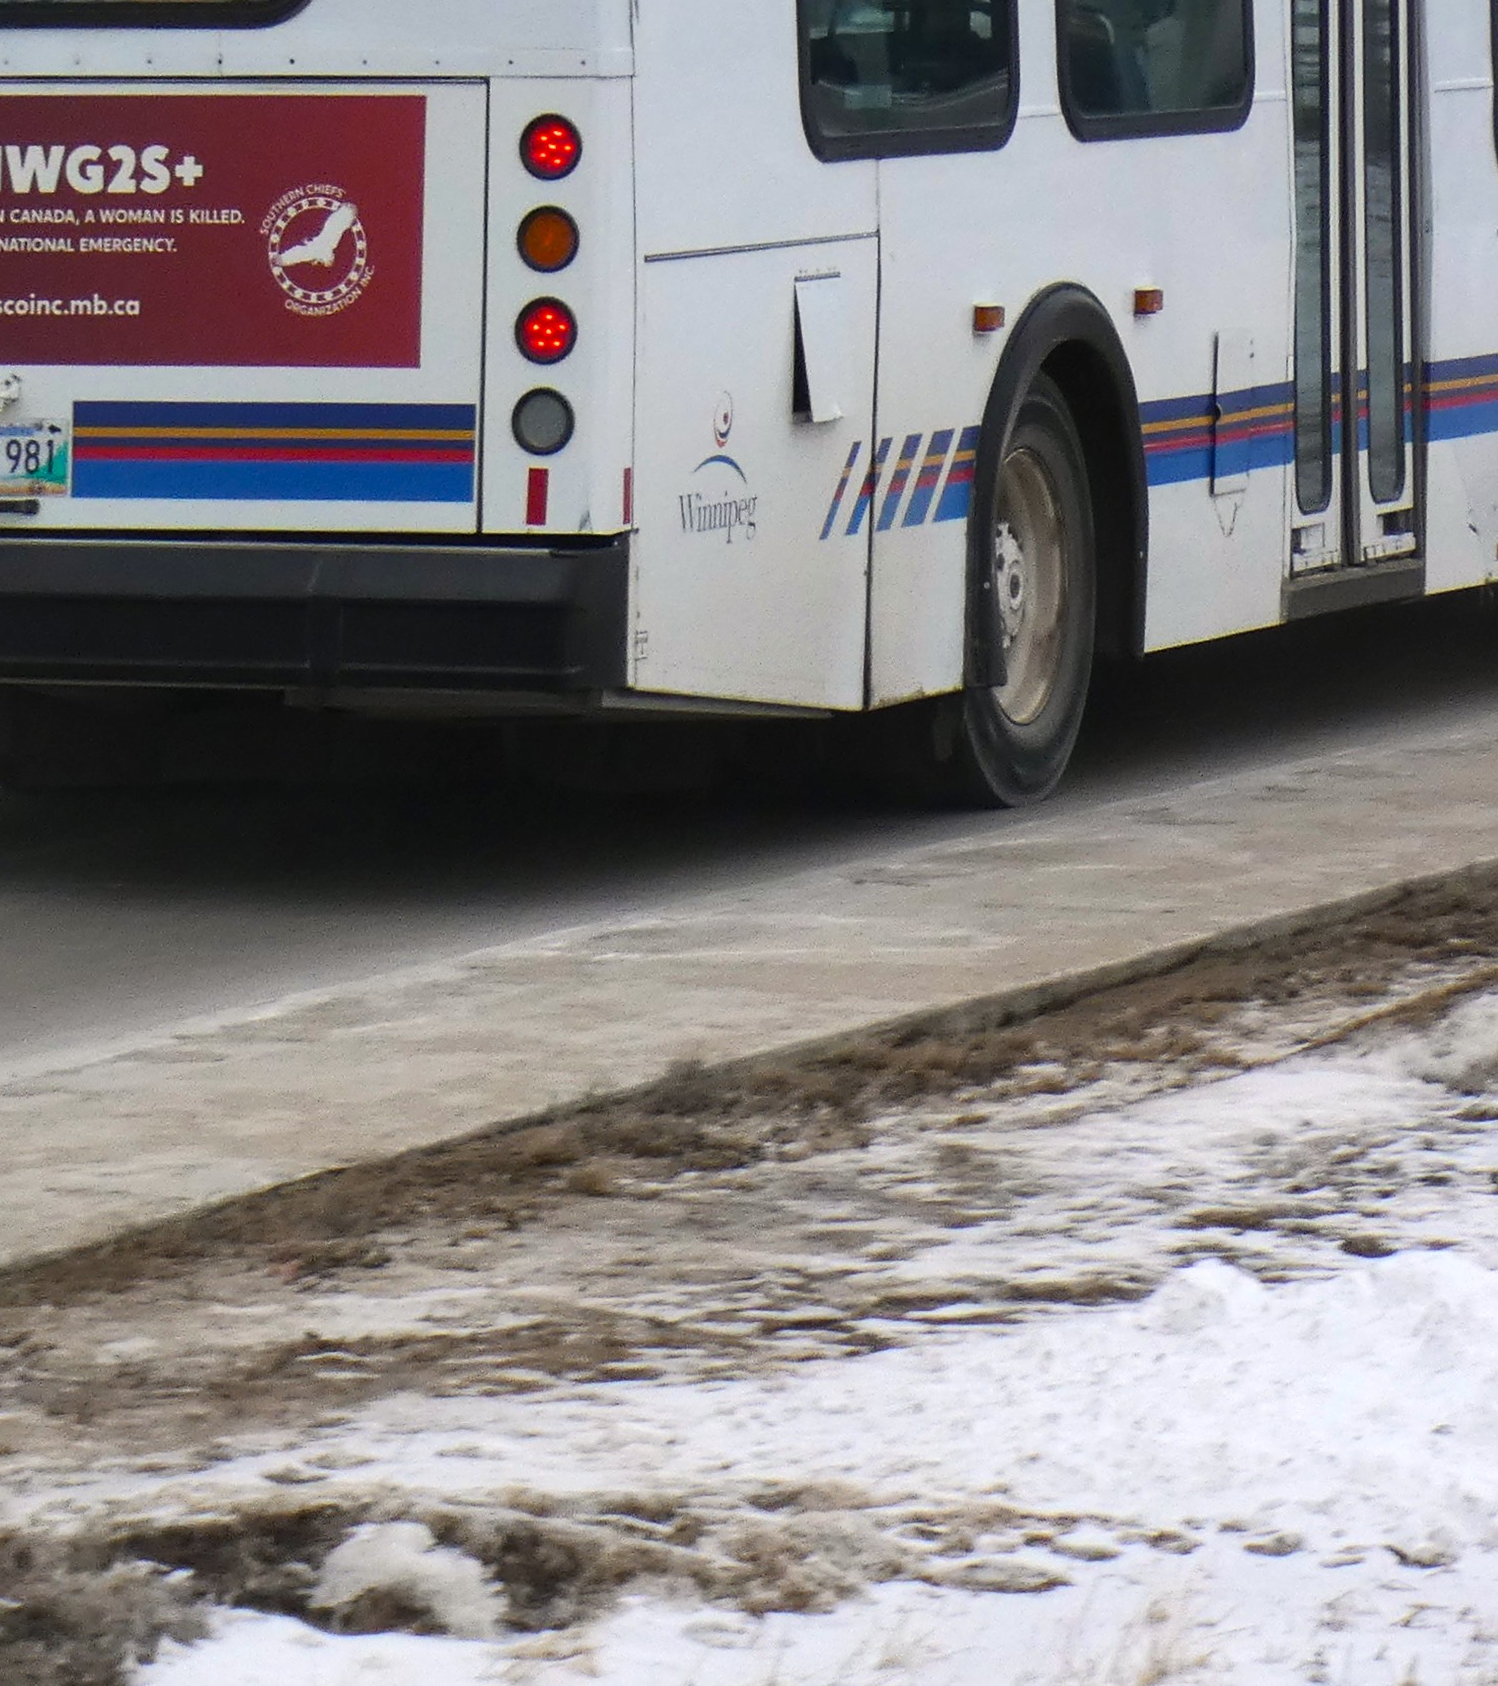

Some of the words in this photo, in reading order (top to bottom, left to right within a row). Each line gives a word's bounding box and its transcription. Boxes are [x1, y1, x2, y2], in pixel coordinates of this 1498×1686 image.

[10, 209, 80, 226] CANADA,
[84, 209, 96, 223] A
[100, 209, 165, 224] WOMAN
[170, 209, 184, 224] IS
[189, 209, 245, 225] KILLED.
[259, 186, 304, 235] SOUTHERN
[305, 184, 346, 198] CHIEFS
[79, 237, 178, 253] EMERGENCY.
[284, 285, 362, 315] ORGANIZATION
[5, 439, 54, 474] 981
[679, 491, 757, 544] Winnipeg
